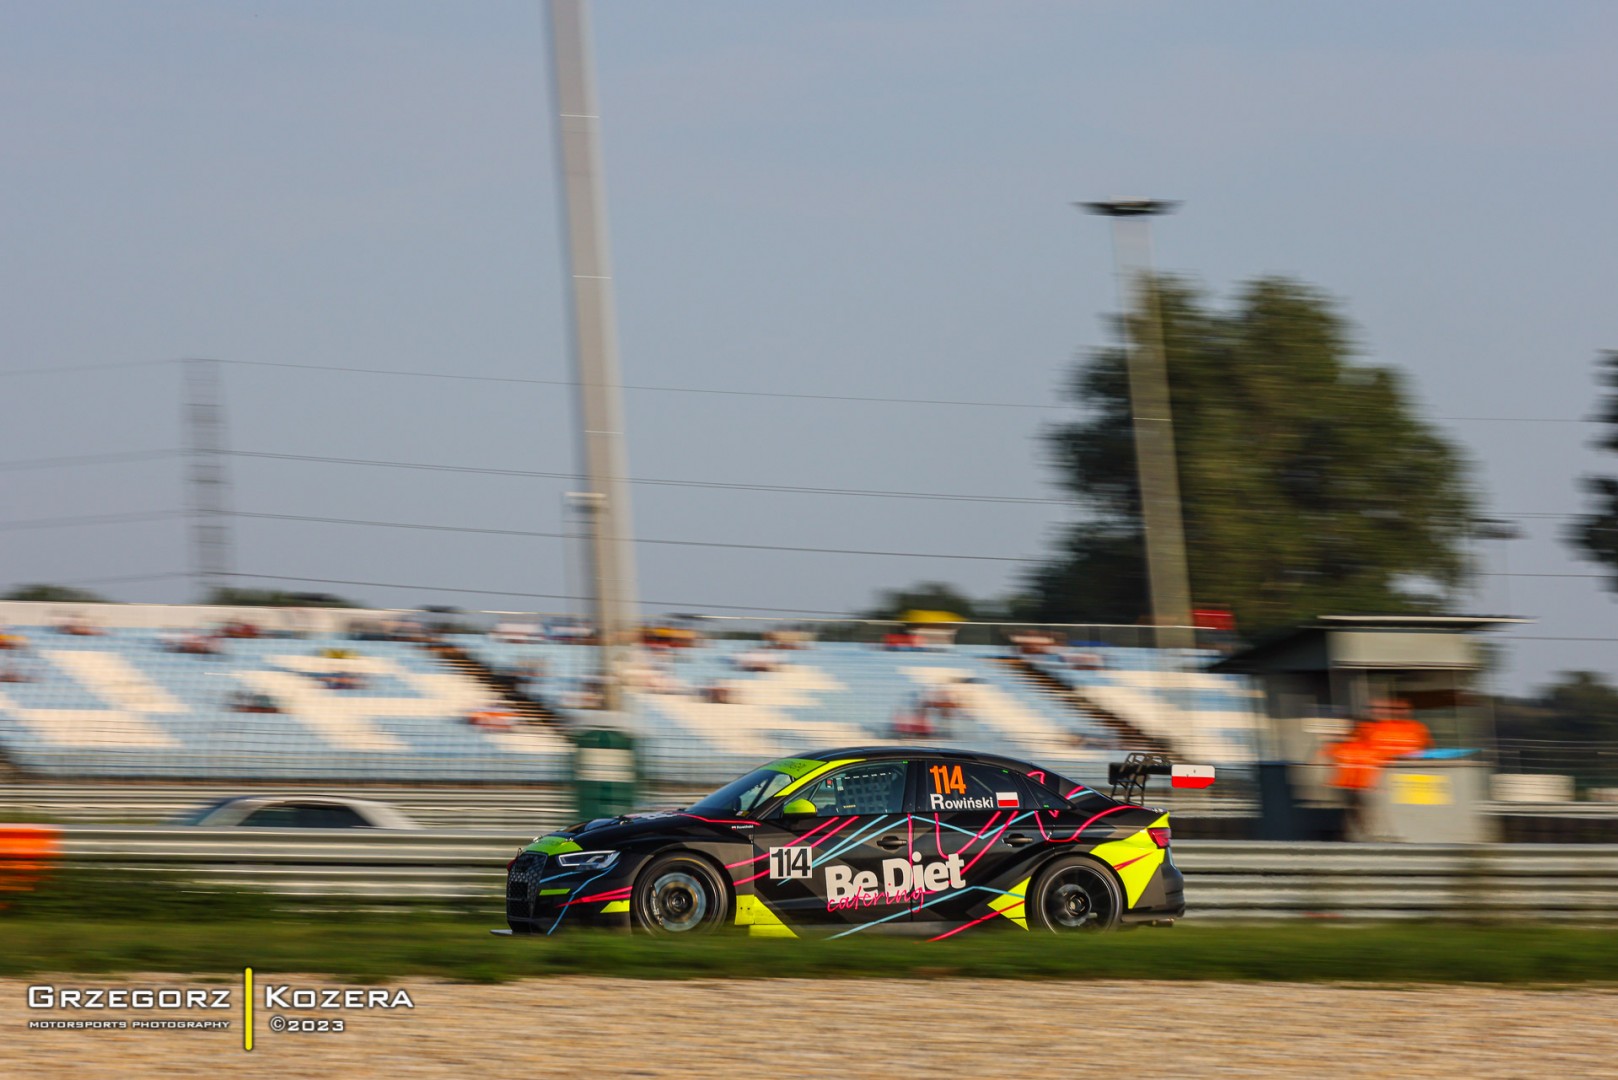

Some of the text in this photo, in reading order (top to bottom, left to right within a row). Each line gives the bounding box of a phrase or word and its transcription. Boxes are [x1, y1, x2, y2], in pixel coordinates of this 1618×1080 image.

[930, 765, 967, 795] 114
[930, 793, 994, 810] Rowiński
[770, 848, 811, 878] 114
[824, 851, 967, 902] Be Diet
[826, 882, 925, 913] catering
